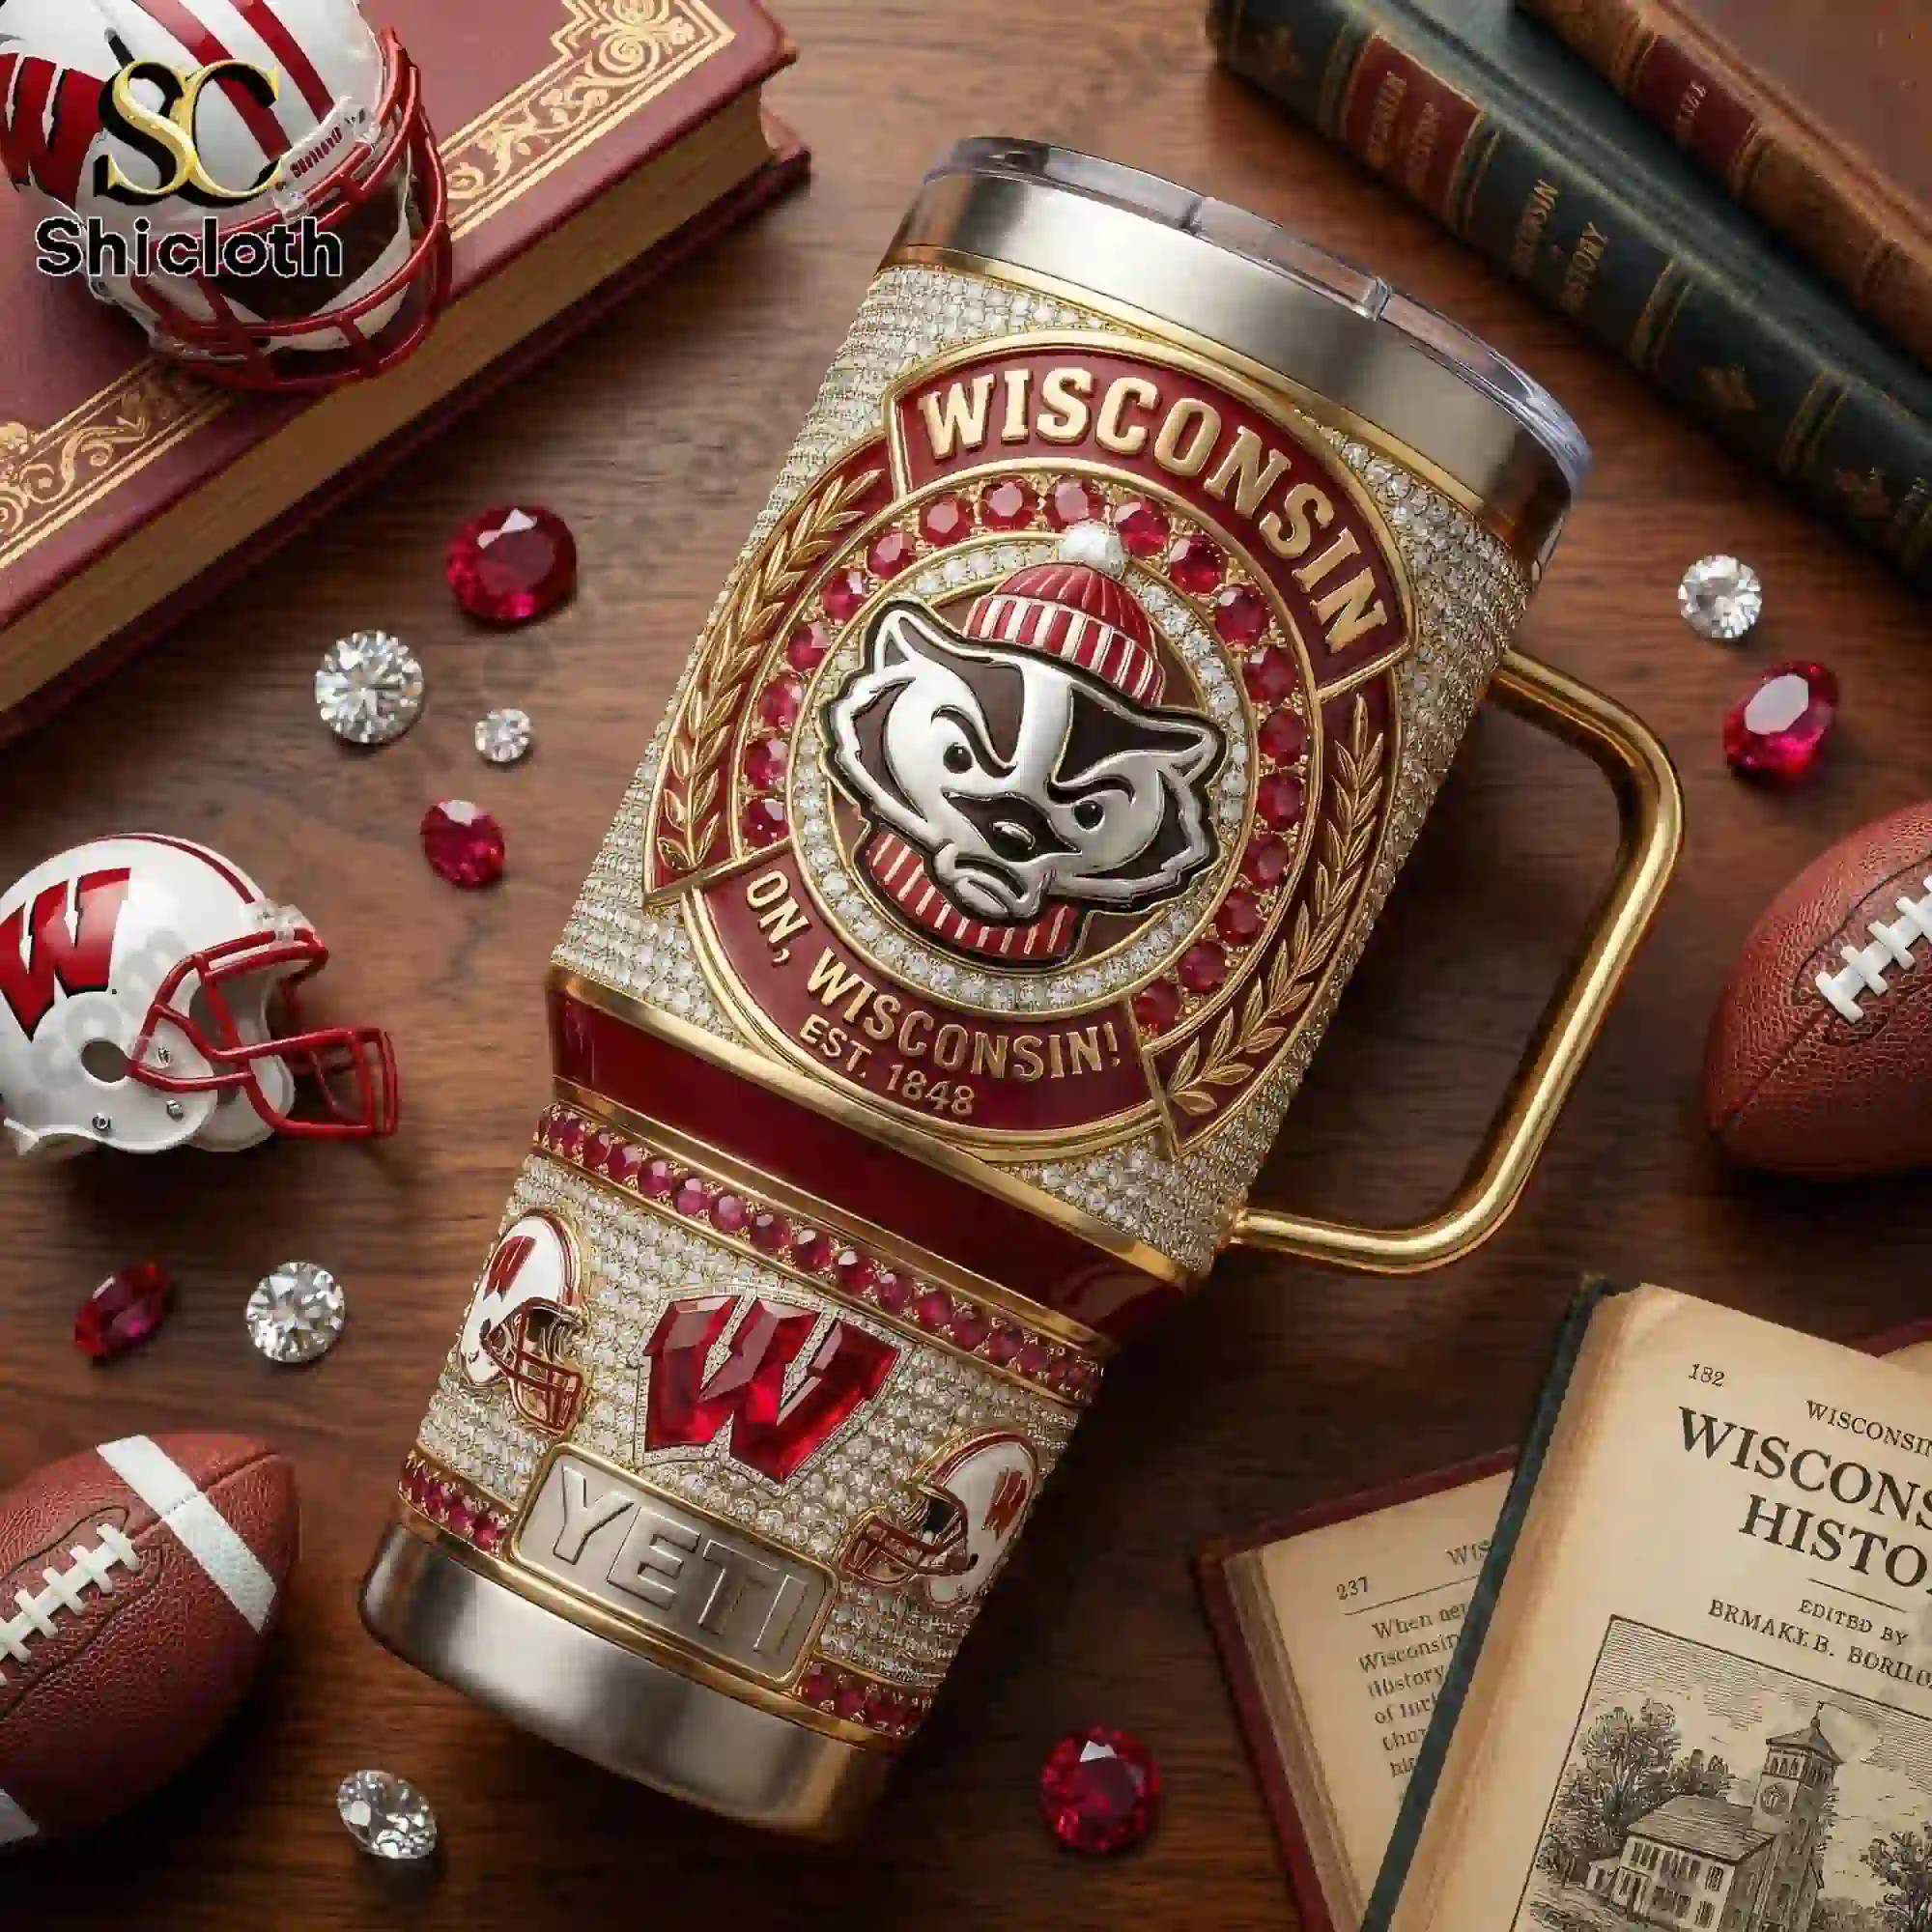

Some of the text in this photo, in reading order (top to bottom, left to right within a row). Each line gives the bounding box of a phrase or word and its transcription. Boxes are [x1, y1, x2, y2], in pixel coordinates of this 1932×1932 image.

[917, 367, 1387, 655] WISCONSIN
[746, 869, 1121, 1082] ON, WISCONSIN!
[800, 1013, 975, 1116] EST. 1848
[642, 1293, 901, 1482] W
[1689, 1363, 1725, 1387] 182
[552, 1465, 809, 1654] YETI
[1336, 1577, 1369, 1601] 237
[1739, 1493, 1932, 1595] HISTO
[1880, 1626, 1910, 1647] BY
